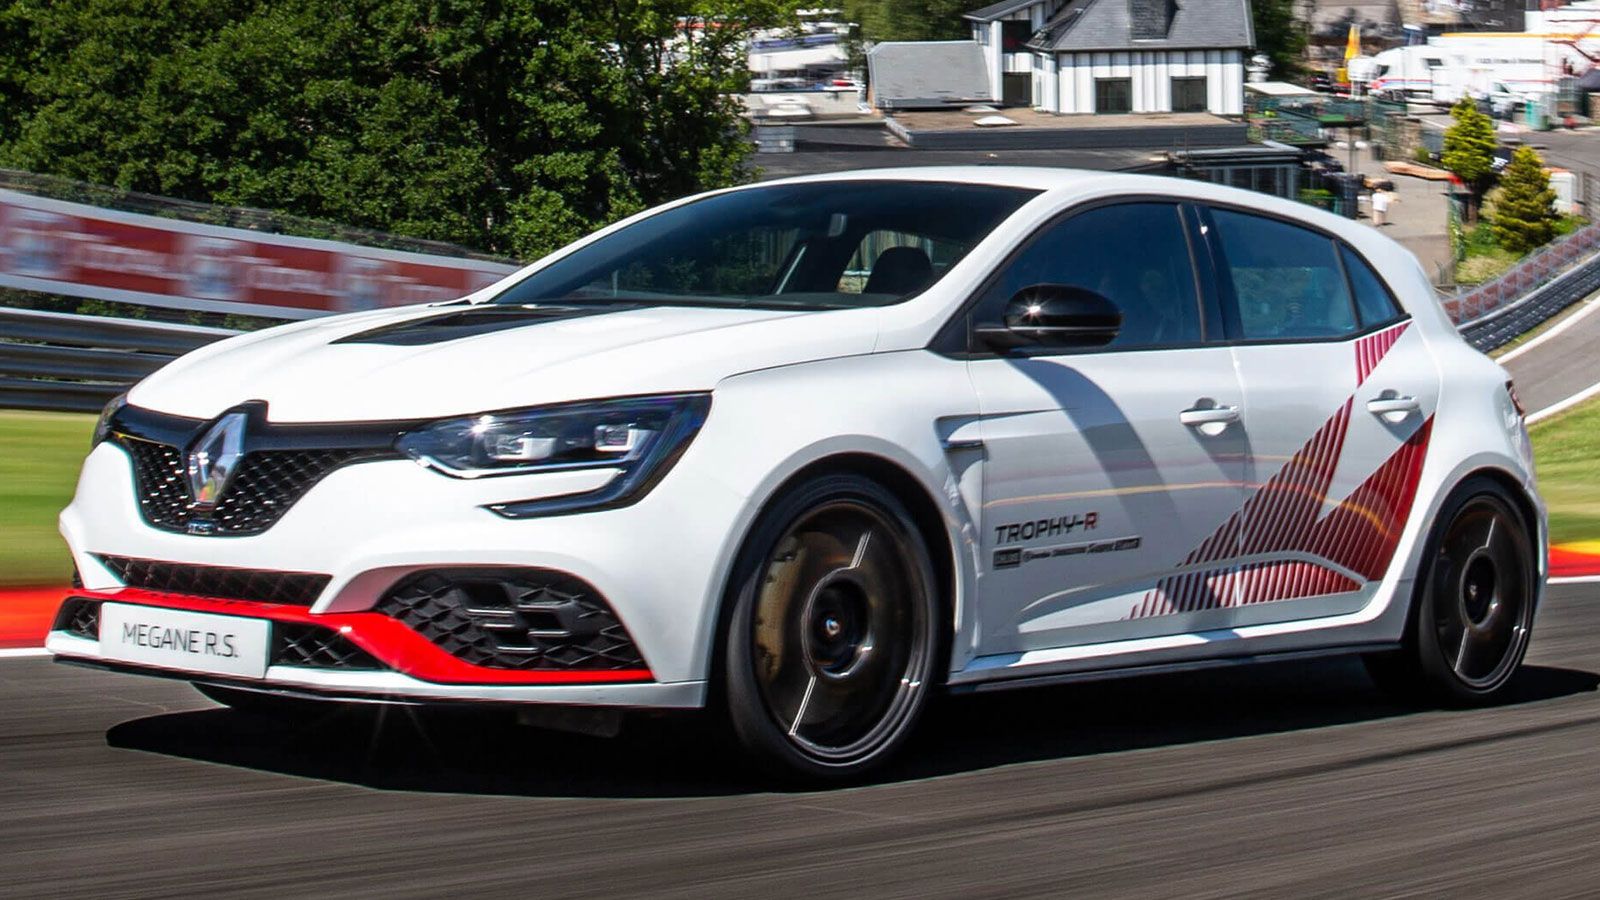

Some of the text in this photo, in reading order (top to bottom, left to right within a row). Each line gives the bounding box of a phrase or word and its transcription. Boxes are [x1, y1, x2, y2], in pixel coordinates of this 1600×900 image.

[995, 512, 1098, 545] TROPHY-R
[122, 622, 239, 658] MEGANE R.S.
